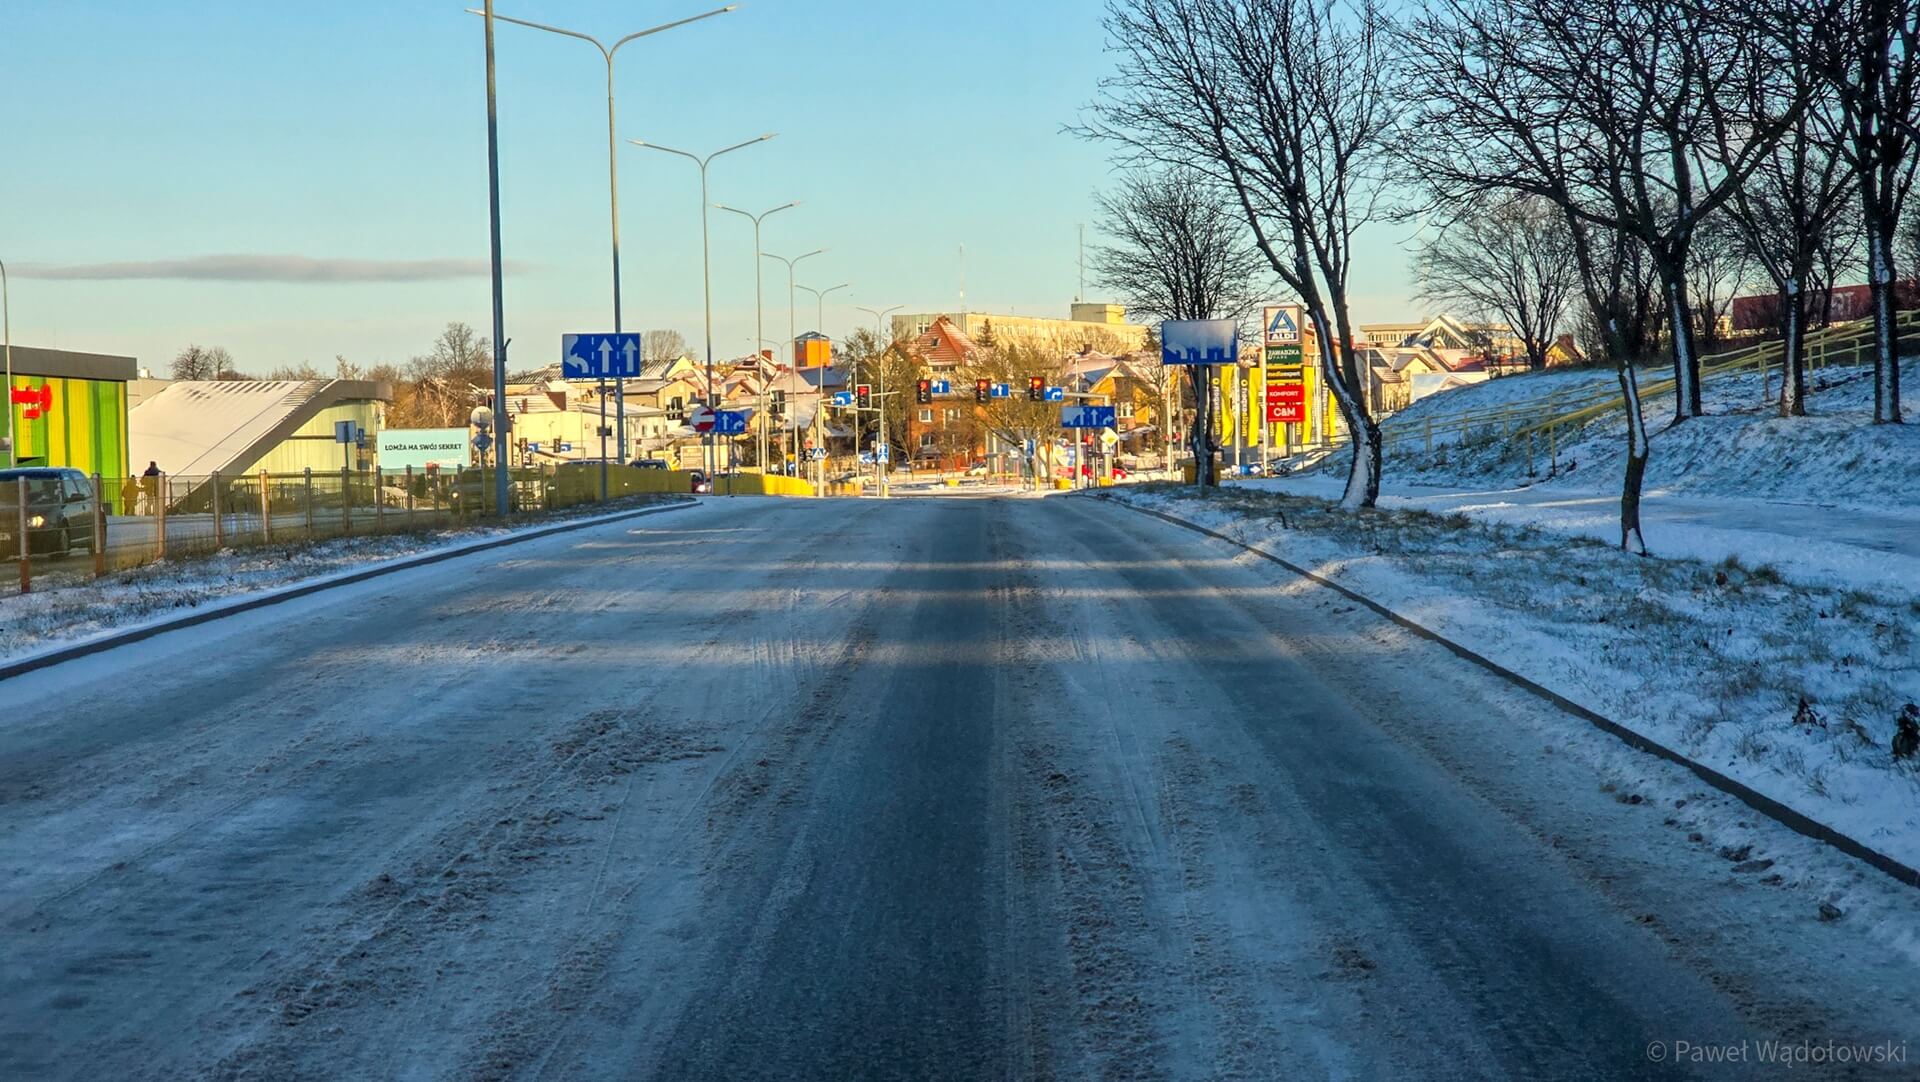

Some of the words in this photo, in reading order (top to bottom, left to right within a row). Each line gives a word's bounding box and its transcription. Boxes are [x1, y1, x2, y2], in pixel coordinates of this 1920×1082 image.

[1267, 349, 1300, 360] ZAWADZKA
[1273, 407, 1296, 417] C&M
[419, 442, 437, 450] SWÓJ
